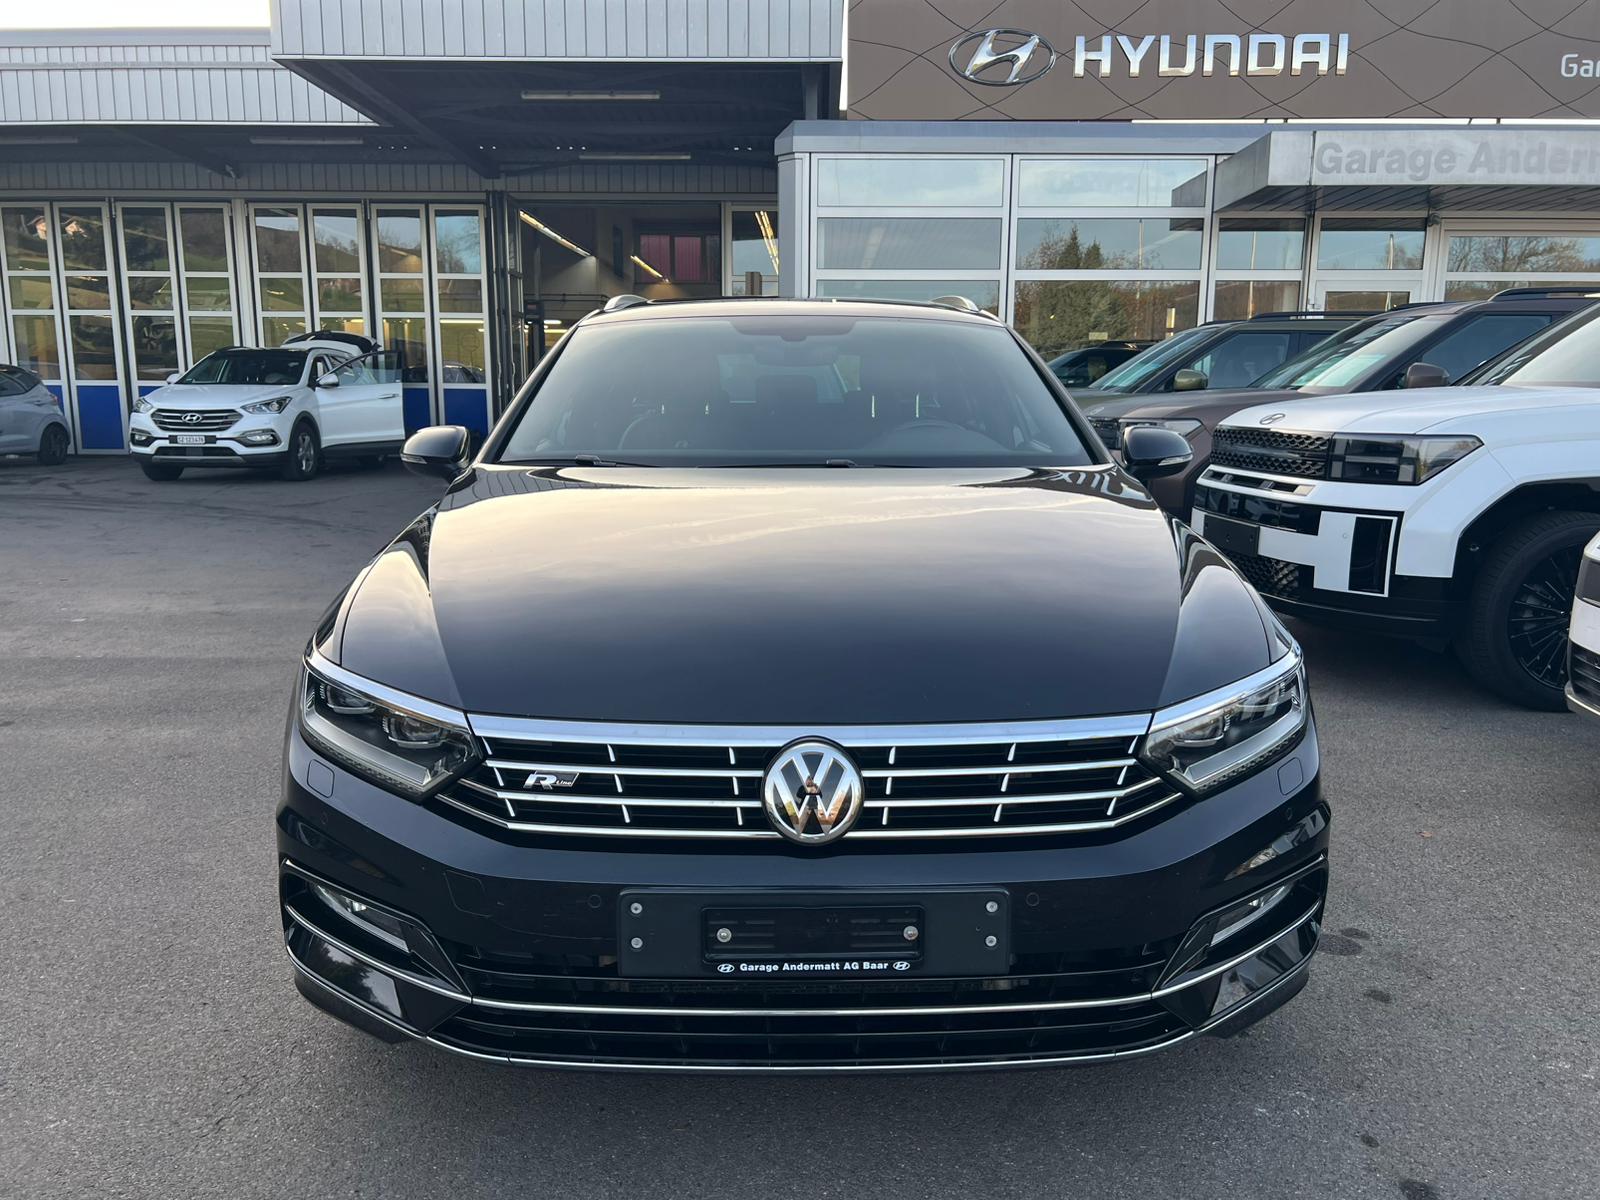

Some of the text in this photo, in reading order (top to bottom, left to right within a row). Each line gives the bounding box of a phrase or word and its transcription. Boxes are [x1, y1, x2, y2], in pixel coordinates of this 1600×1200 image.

[1074, 33, 1348, 77] HYUNDAI
[1315, 142, 1456, 181] Garage
[740, 961, 889, 972] Garage Andermatt AG Baar
